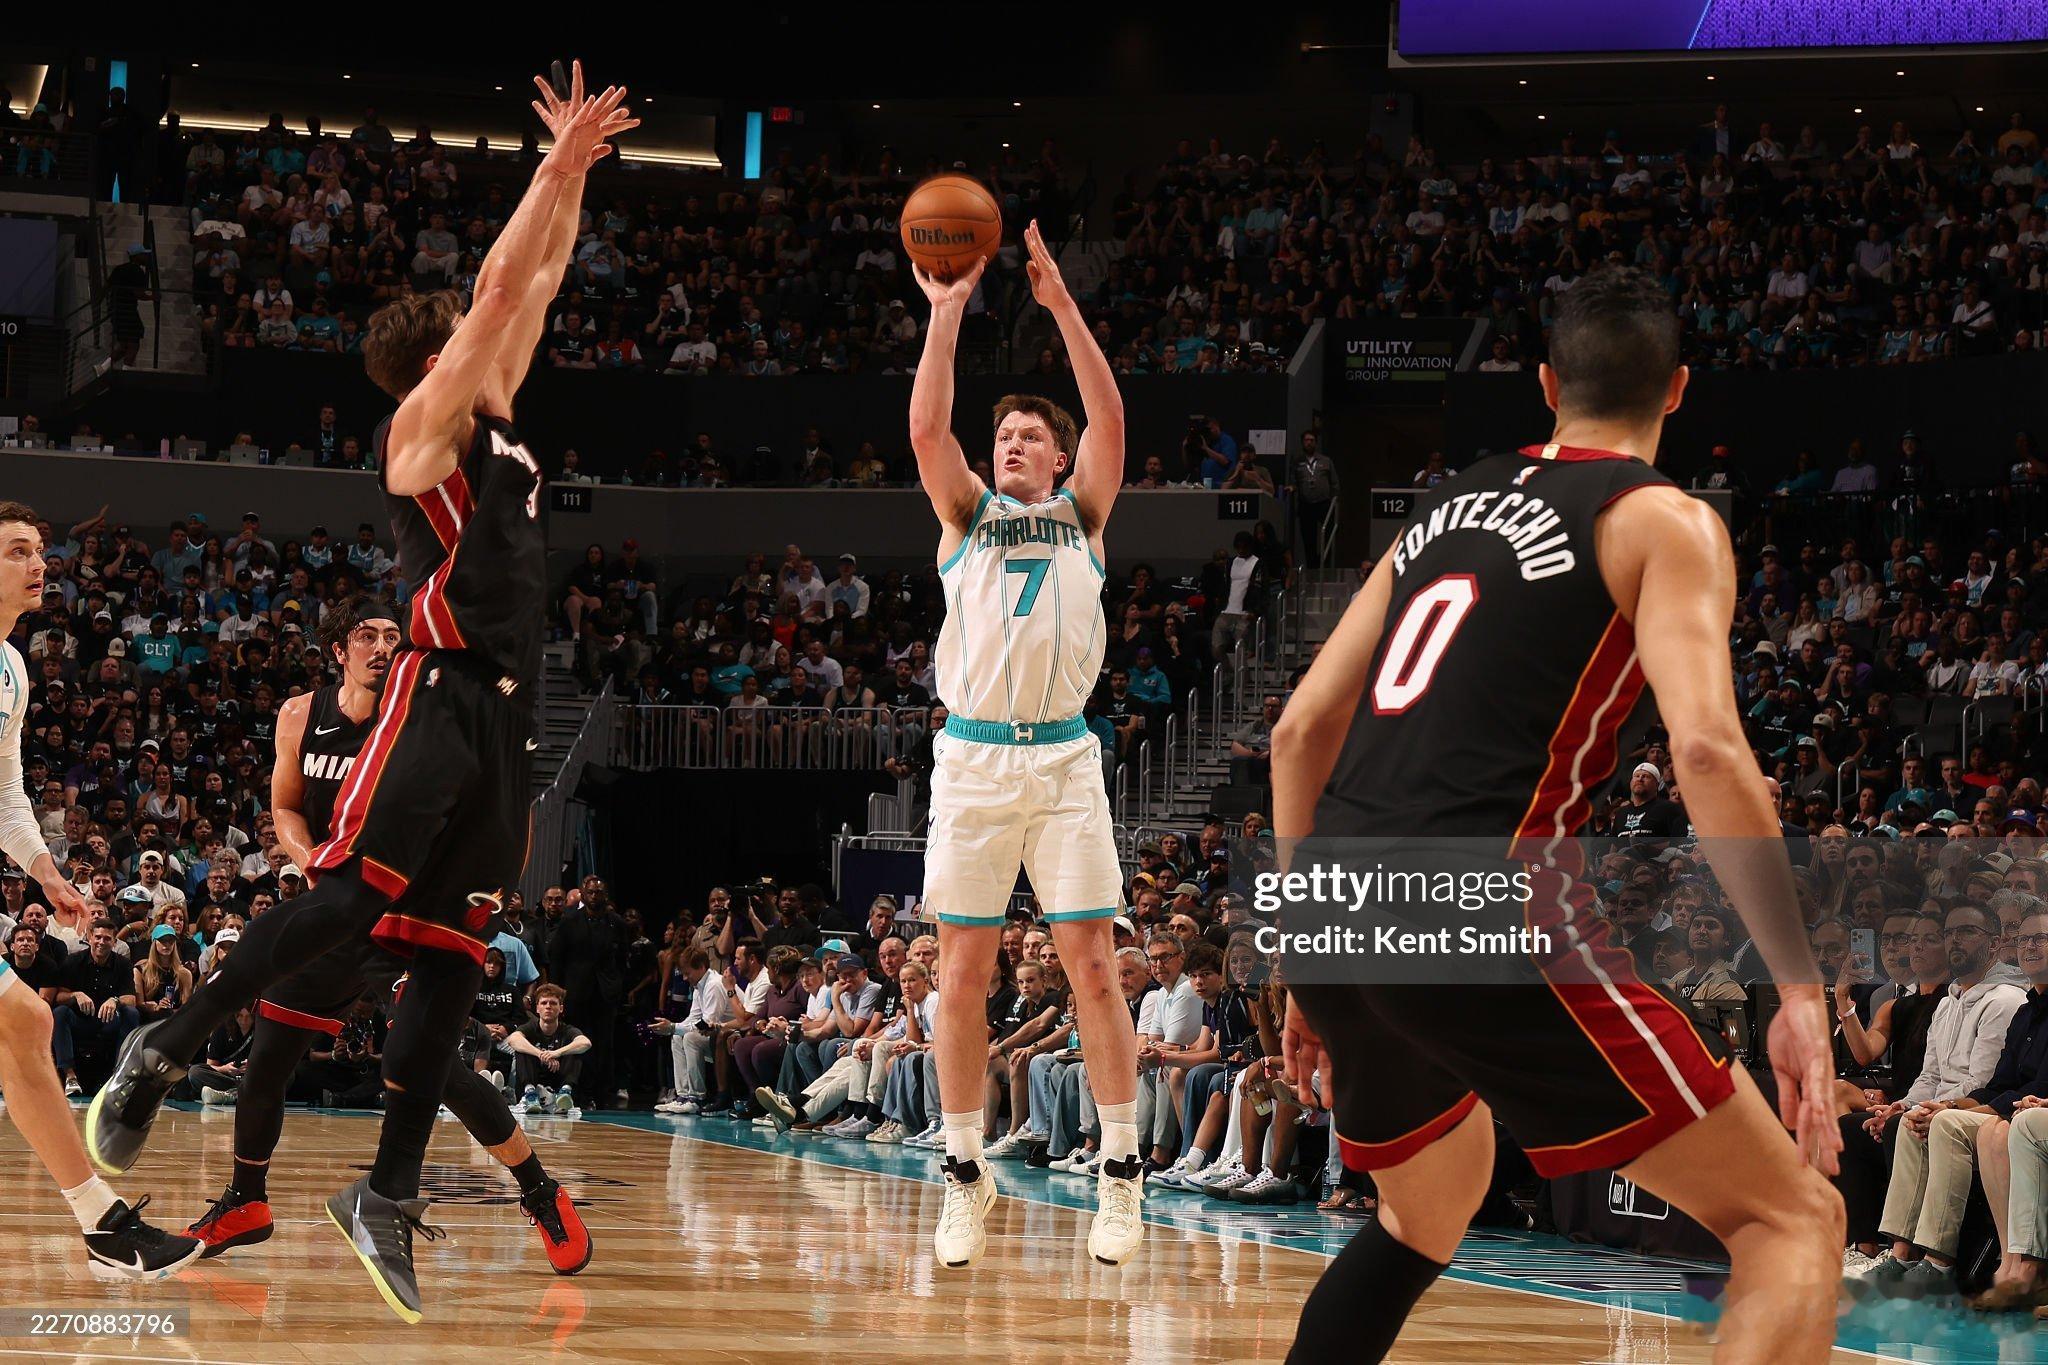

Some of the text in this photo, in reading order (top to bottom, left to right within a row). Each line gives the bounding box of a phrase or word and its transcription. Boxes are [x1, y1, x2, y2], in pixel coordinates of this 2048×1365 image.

[910, 226, 975, 246] Wilson
[1346, 341, 1413, 354] UTILITY
[1367, 357, 1452, 368] INNOVATION
[1345, 370, 1389, 381] GROUP
[561, 493, 581, 506] 111
[1228, 500, 1248, 513] 111
[1382, 499, 1405, 513] 112
[977, 516, 1081, 553] CHARLOTTE
[1393, 491, 1575, 581] FONTECCHIO
[1005, 558, 1052, 617] 7
[144, 643, 171, 657] CLT
[1372, 573, 1480, 716] 0
[303, 752, 357, 780] MIA
